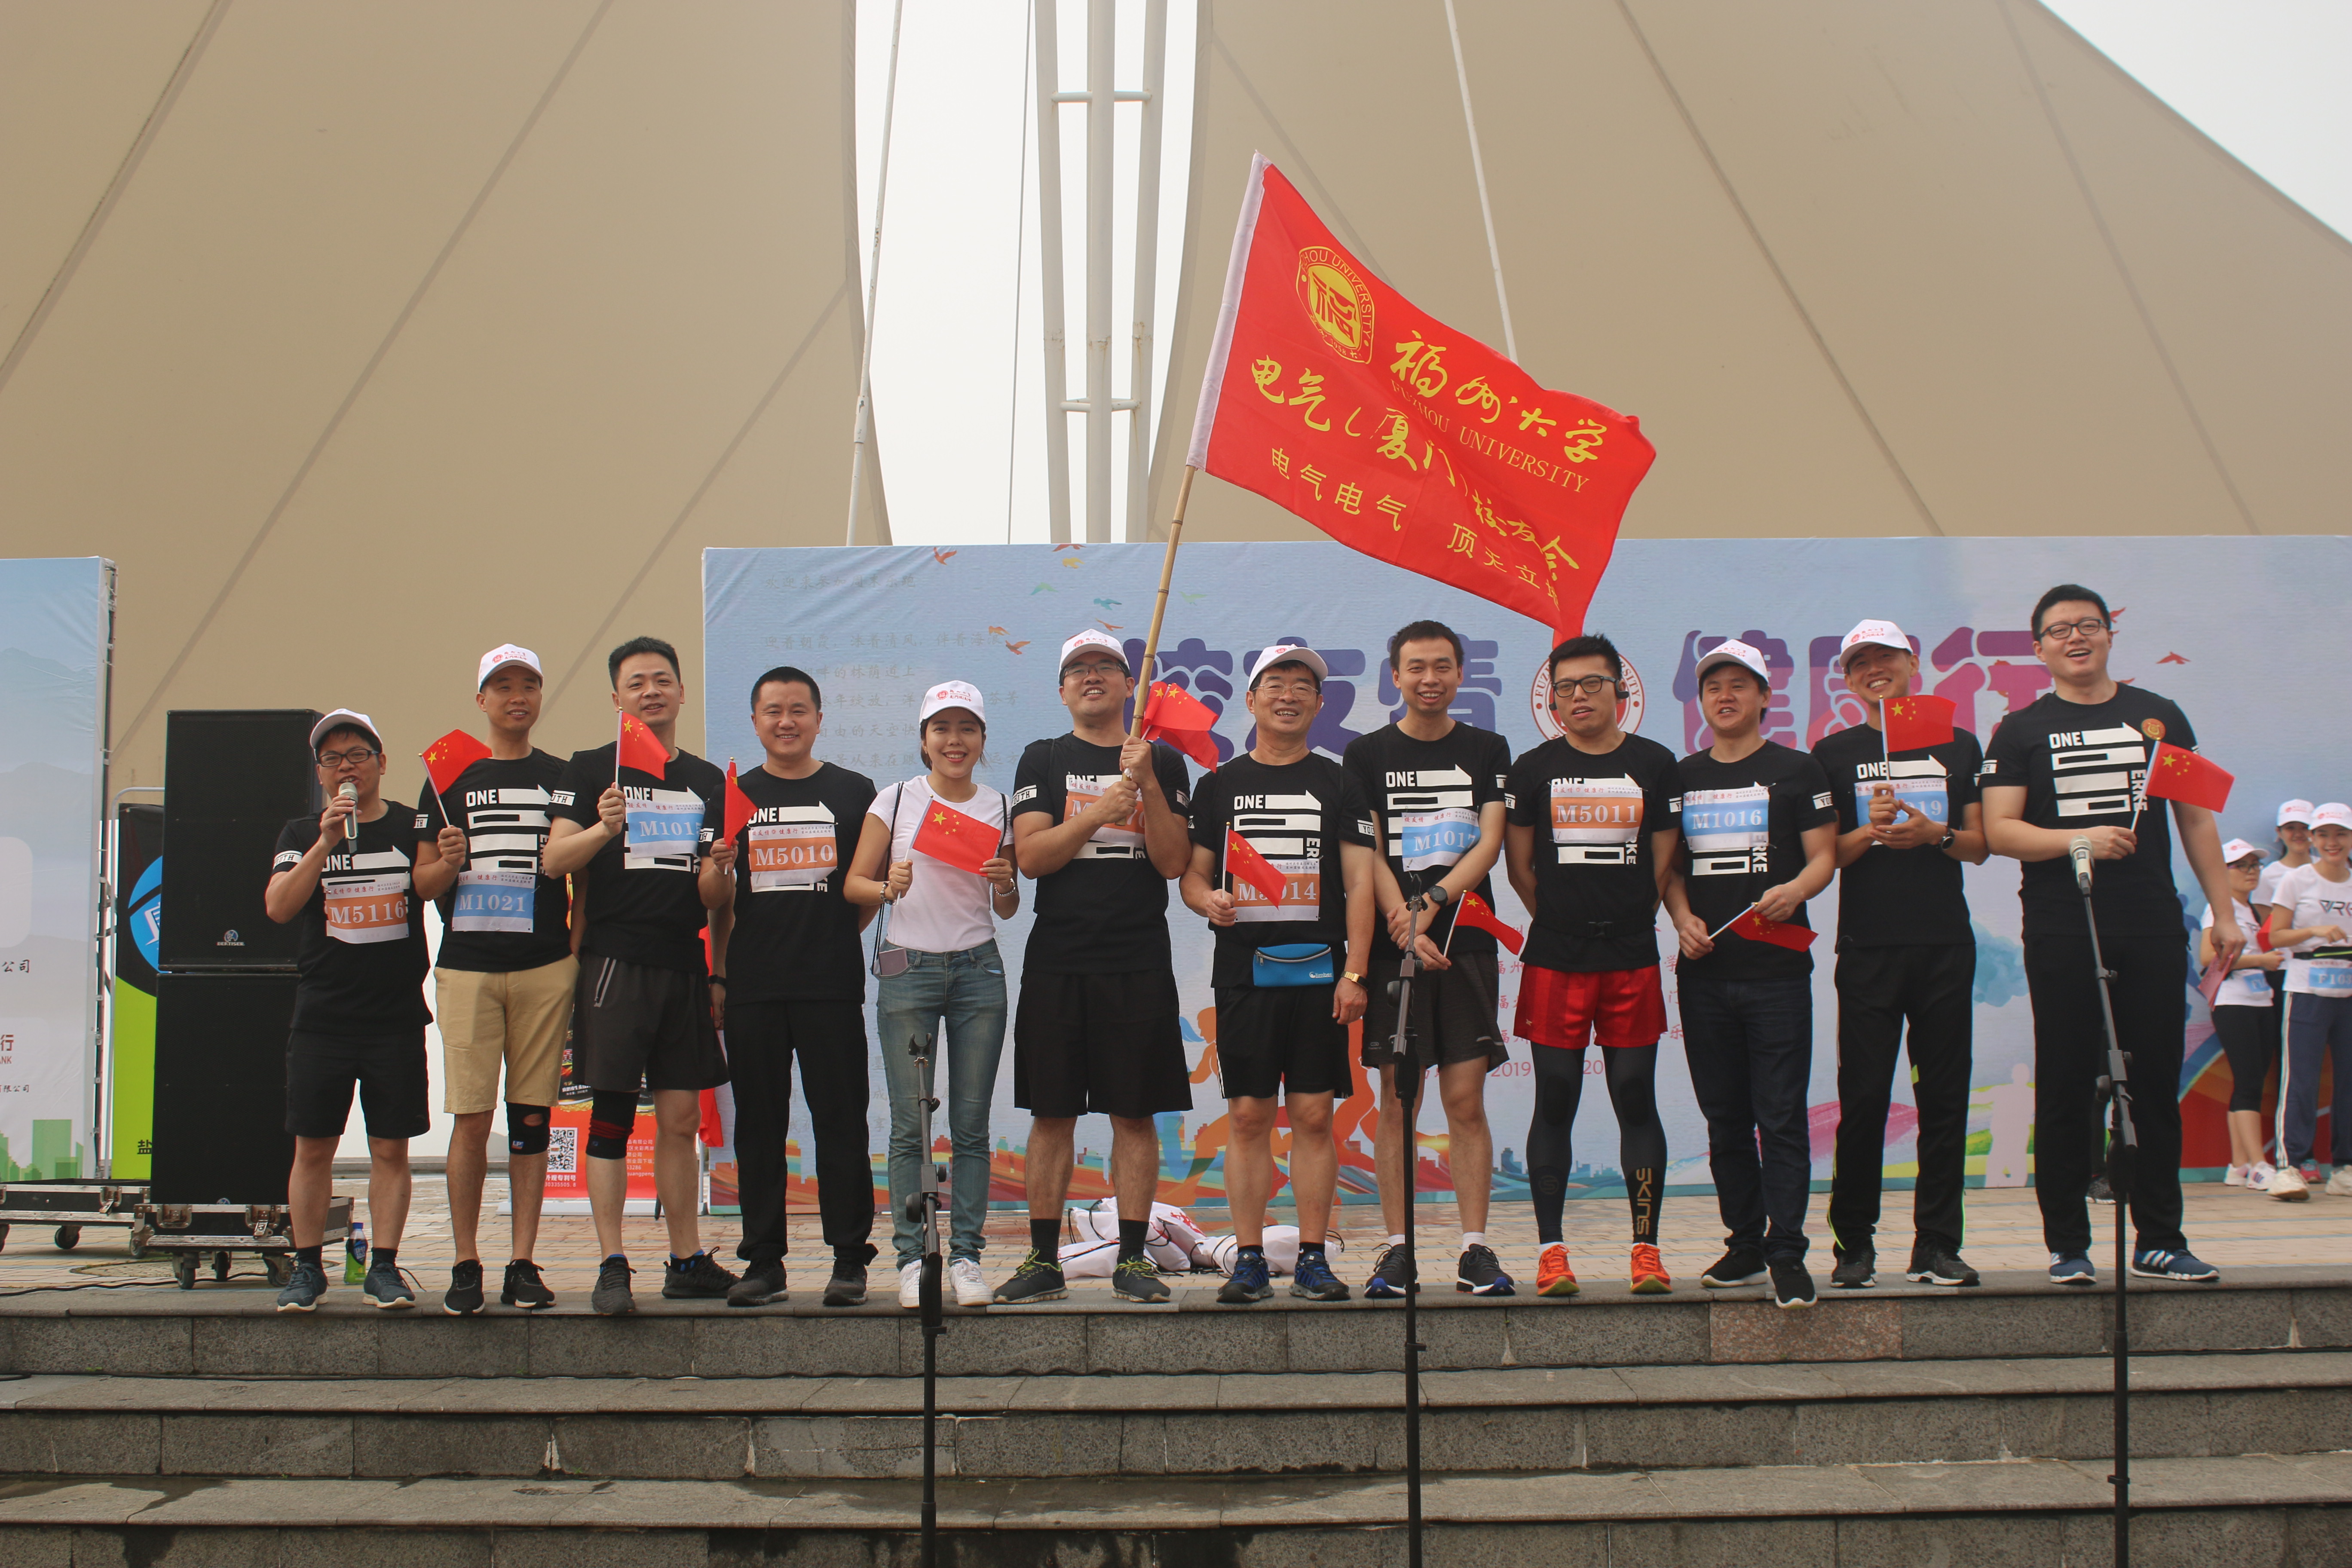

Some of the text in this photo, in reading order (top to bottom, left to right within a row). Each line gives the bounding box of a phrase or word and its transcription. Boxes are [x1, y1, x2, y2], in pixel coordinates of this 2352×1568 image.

[1332, 255, 1372, 340] UNIVERSITY
[1390, 330, 1608, 463] 福州大学
[1391, 379, 1589, 493] FUZHOU UNIVERSITY
[1271, 447, 1406, 532] 电气电气
[2049, 732, 2081, 749] ONE
[1386, 772, 1415, 787] ONE
[1857, 762, 1887, 779] ONE
[466, 789, 497, 807] ONE
[623, 786, 652, 802] ONE
[1234, 794, 1264, 810] ONE
[1556, 805, 1637, 823] M5011
[1692, 809, 1762, 830] M1016
[1413, 830, 1475, 851] M1017
[754, 844, 833, 866] M5010
[329, 900, 405, 924] M5116
[459, 894, 526, 912] M1021
[2, 959, 30, 974] 公司
